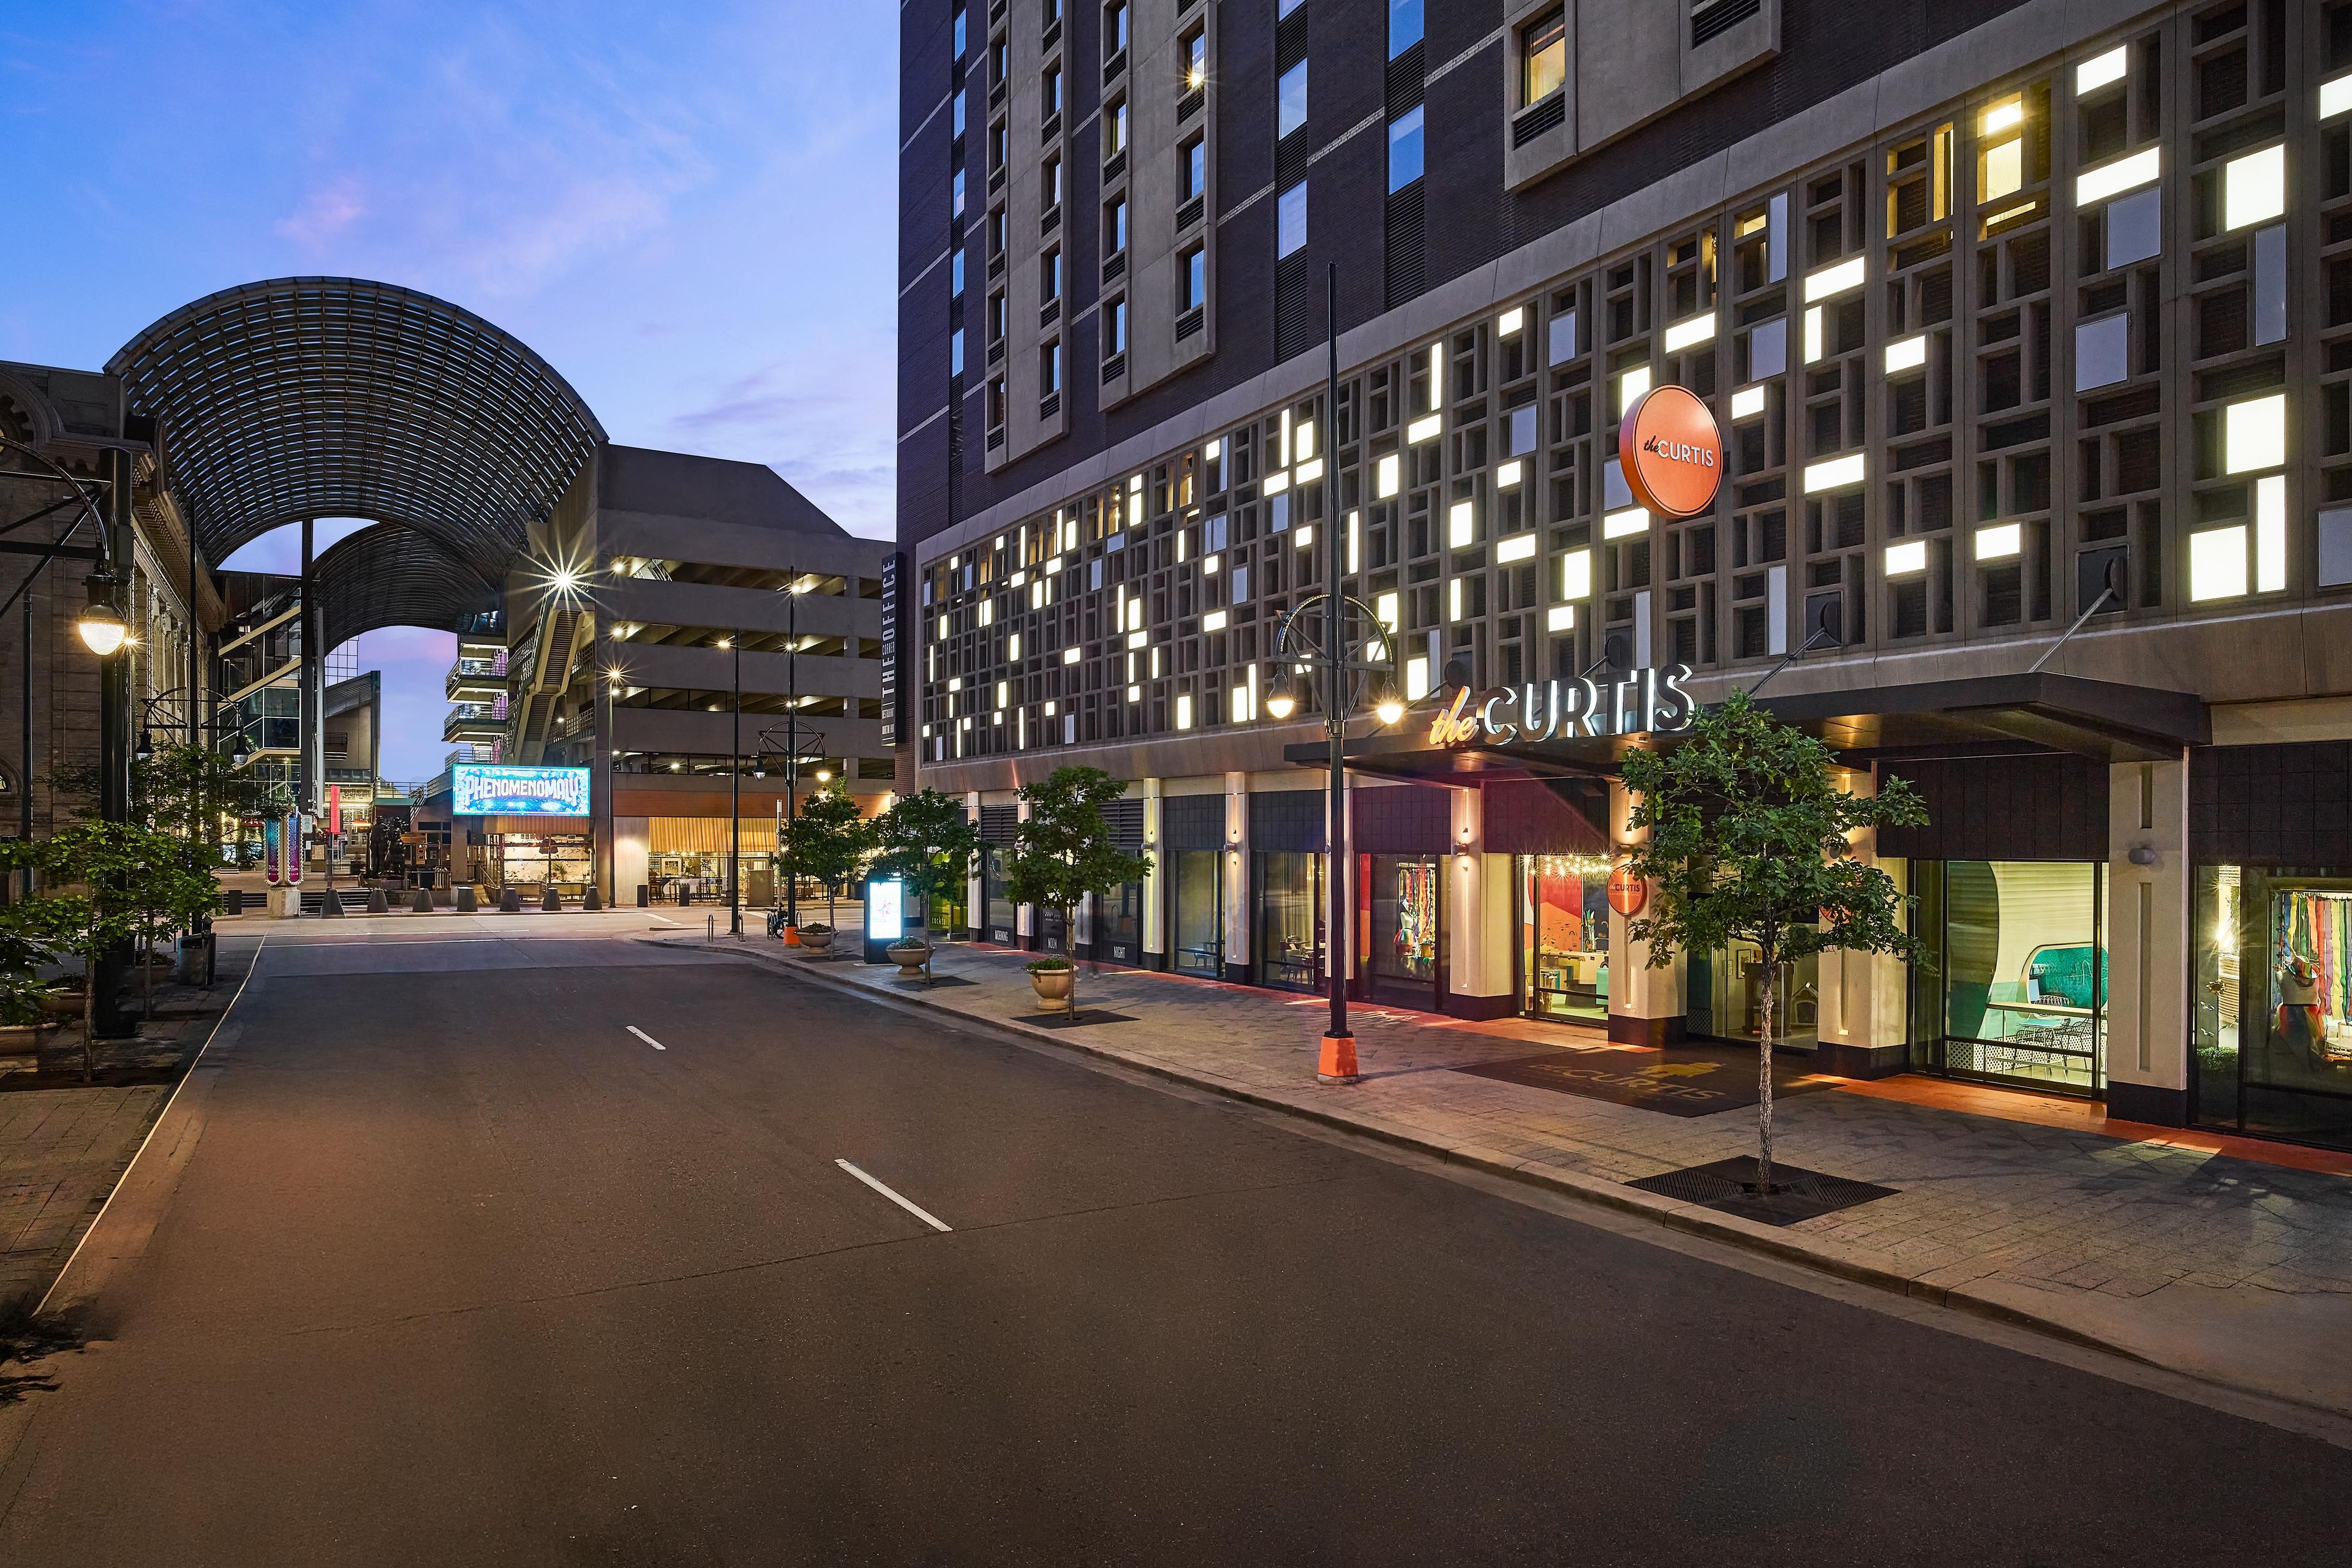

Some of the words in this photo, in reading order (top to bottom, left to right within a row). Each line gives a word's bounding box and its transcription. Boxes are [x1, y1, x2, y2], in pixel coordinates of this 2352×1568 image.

[1644, 435, 1659, 452] the
[1657, 440, 1714, 467] CURTIS
[883, 560, 895, 641] OFFICE
[882, 656, 895, 698] THE
[1429, 685, 1479, 745] the
[1476, 663, 1695, 745] CURTIS
[465, 775, 579, 807] PHENOMENOMALY
[995, 930, 1008, 942] MORNING
[1048, 937, 1057, 949] NOON
[1114, 946, 1126, 959] NIGHT
[1562, 1069, 1725, 1100] CURTIS
